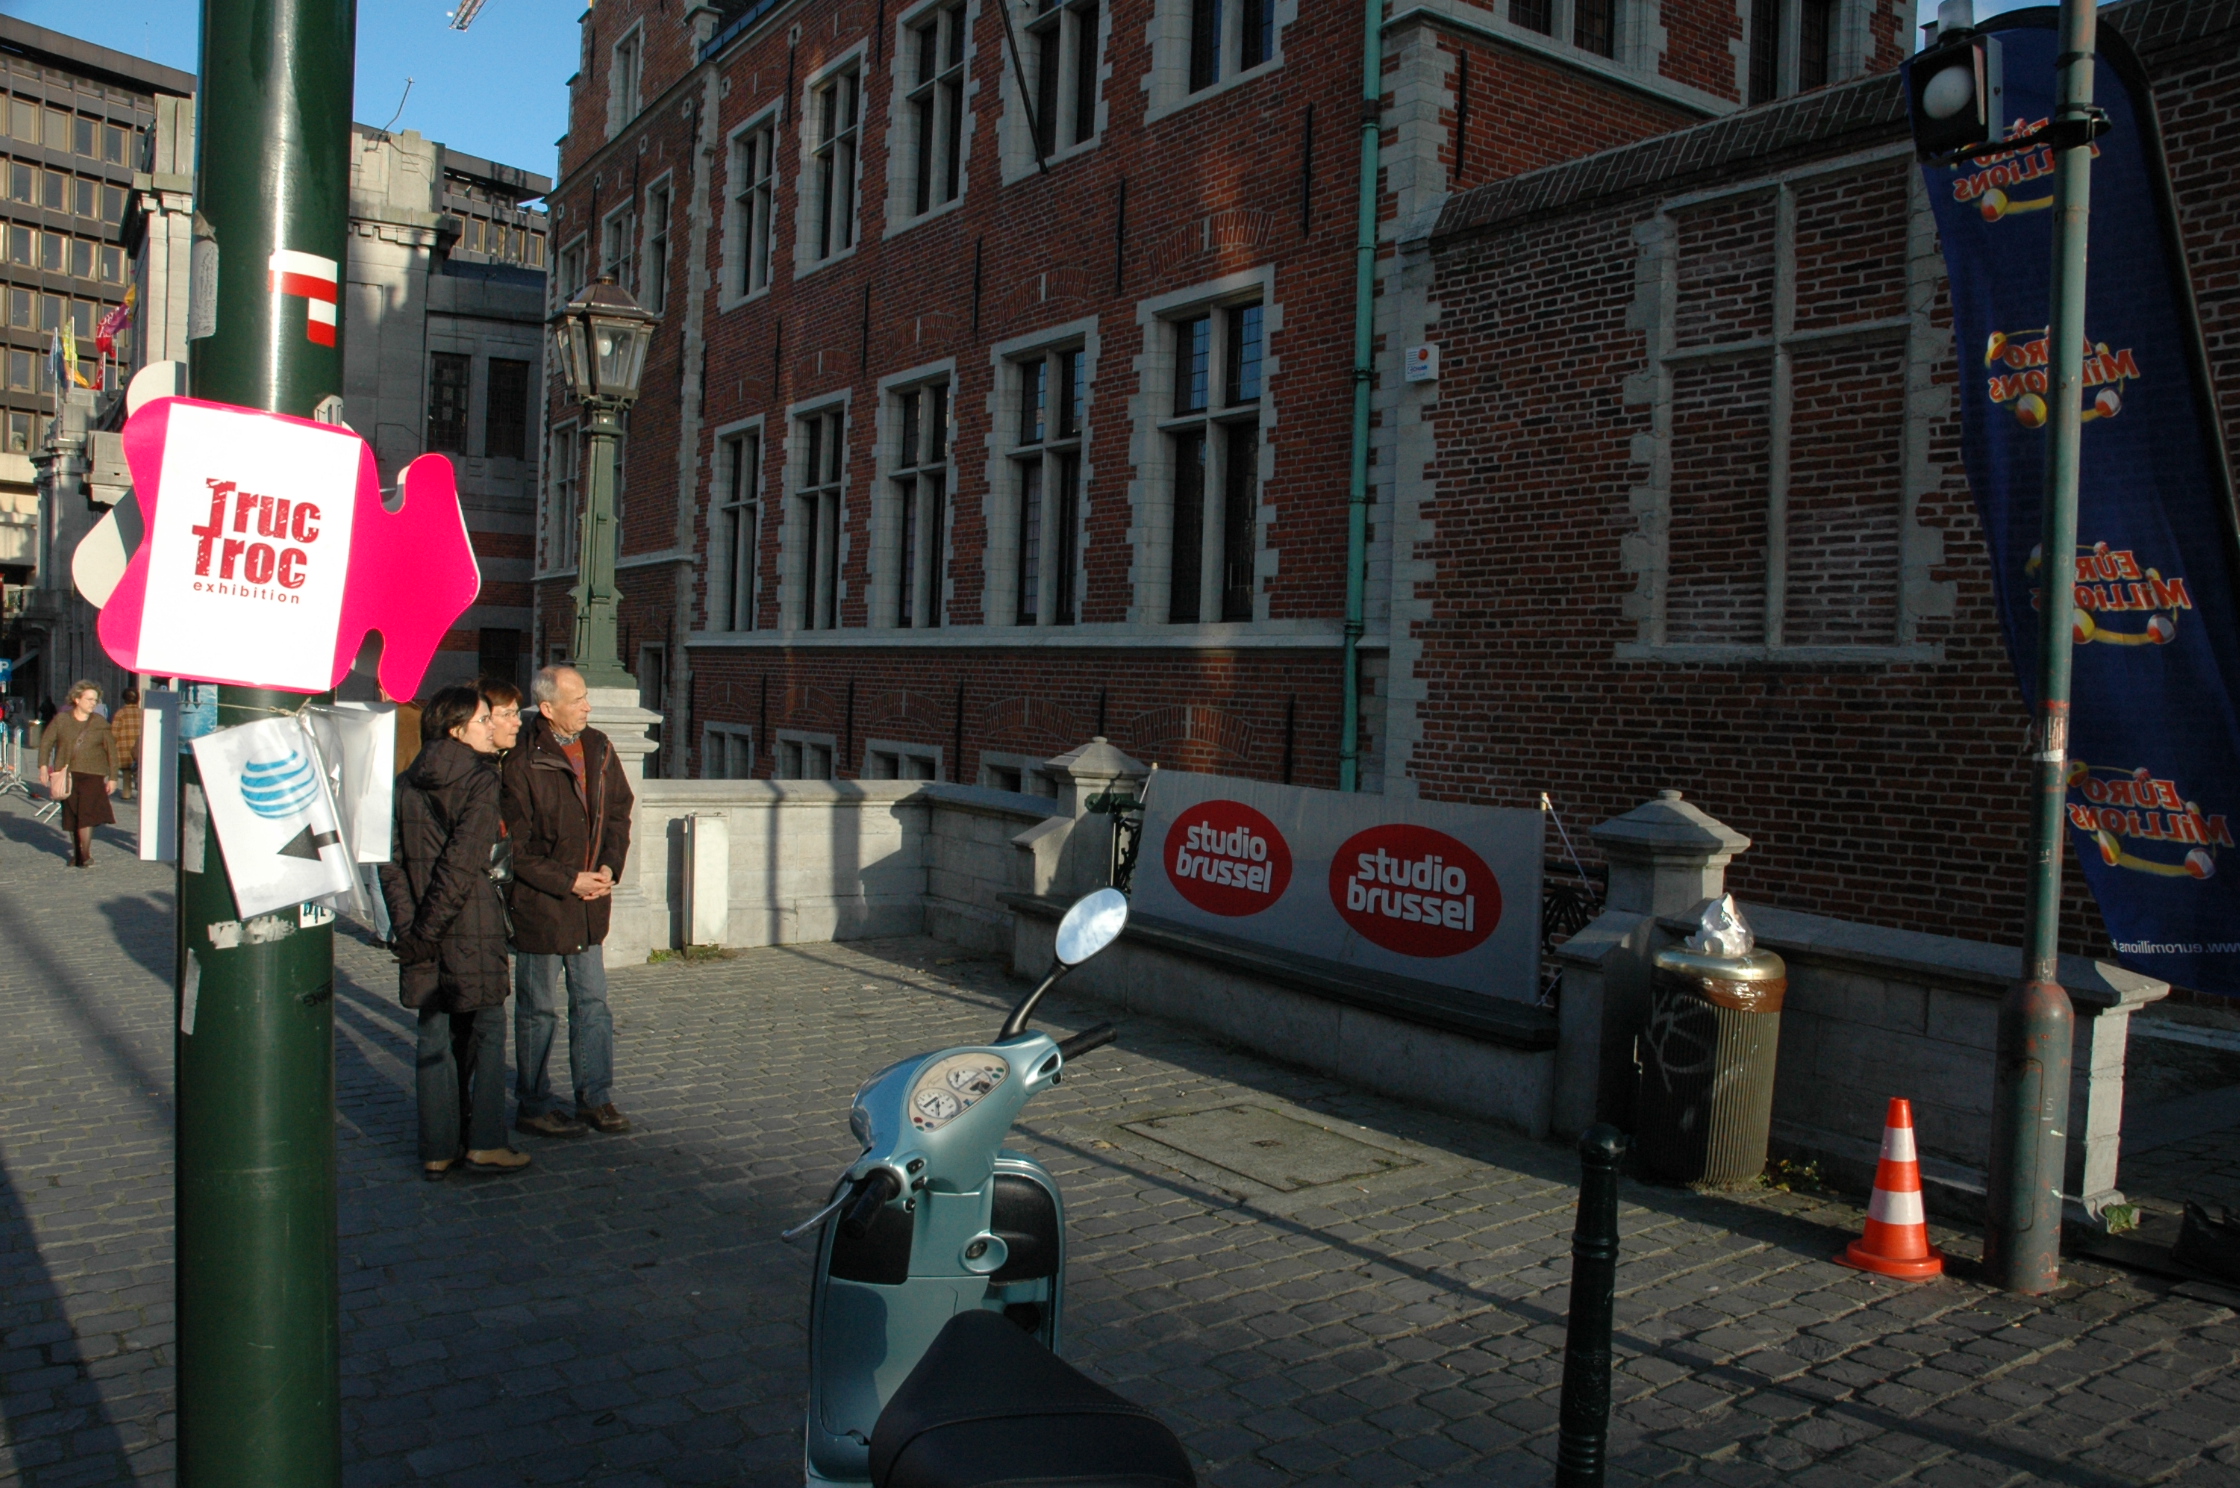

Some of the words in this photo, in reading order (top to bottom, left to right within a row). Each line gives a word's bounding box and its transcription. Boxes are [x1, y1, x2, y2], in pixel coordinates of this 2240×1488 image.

[206, 477, 321, 543] Truc
[192, 524, 307, 589] Troc
[193, 581, 300, 604] exhibition
[1186, 820, 1267, 862] studio
[1176, 845, 1273, 893] brussel
[1357, 847, 1466, 895] studio
[1347, 875, 1475, 931] brussel
